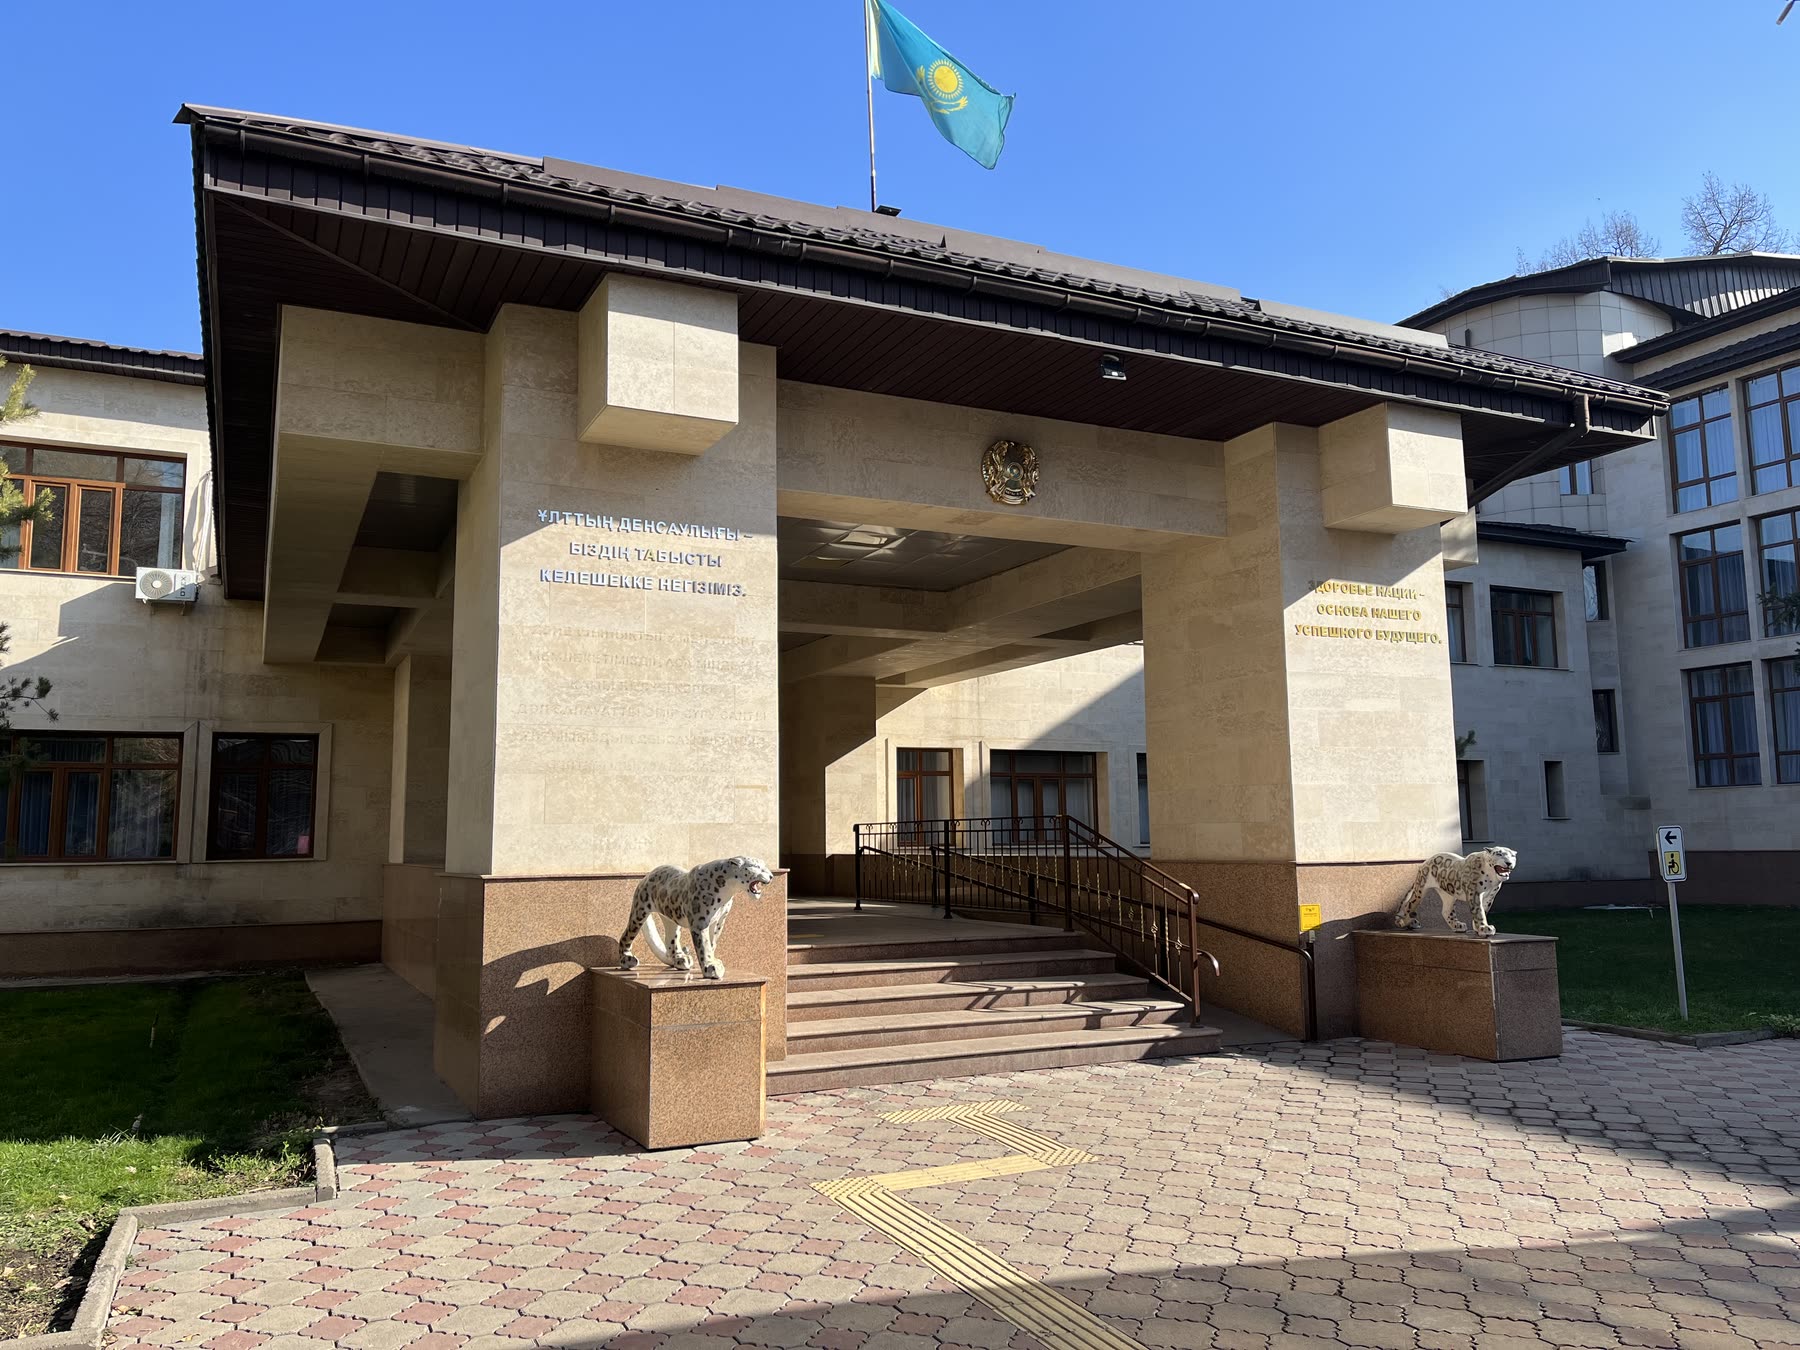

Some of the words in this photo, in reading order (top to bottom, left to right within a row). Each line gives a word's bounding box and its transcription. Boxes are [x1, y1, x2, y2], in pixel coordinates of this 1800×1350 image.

[538, 509, 613, 532] ҰЛТТЫҢ
[618, 517, 740, 542] ДЕНСАУЛЫҒЫ
[569, 541, 629, 562] БІЗДІҢ
[634, 547, 722, 568] ТАБЫСТЫ
[540, 568, 654, 591] КЕЛЕШЕККЕ
[658, 577, 747, 598] НЕГІЗІМІЗ.
[1307, 579, 1374, 597] ЗДОРОВЬЕ
[1375, 585, 1418, 601] НАЦИИ
[1316, 603, 1369, 619] ОСНОВА
[1371, 607, 1422, 622] НАШЕГО
[1295, 624, 1373, 640] УСПЕШНОГО
[1376, 629, 1443, 645] БУДУЩЕГО.
